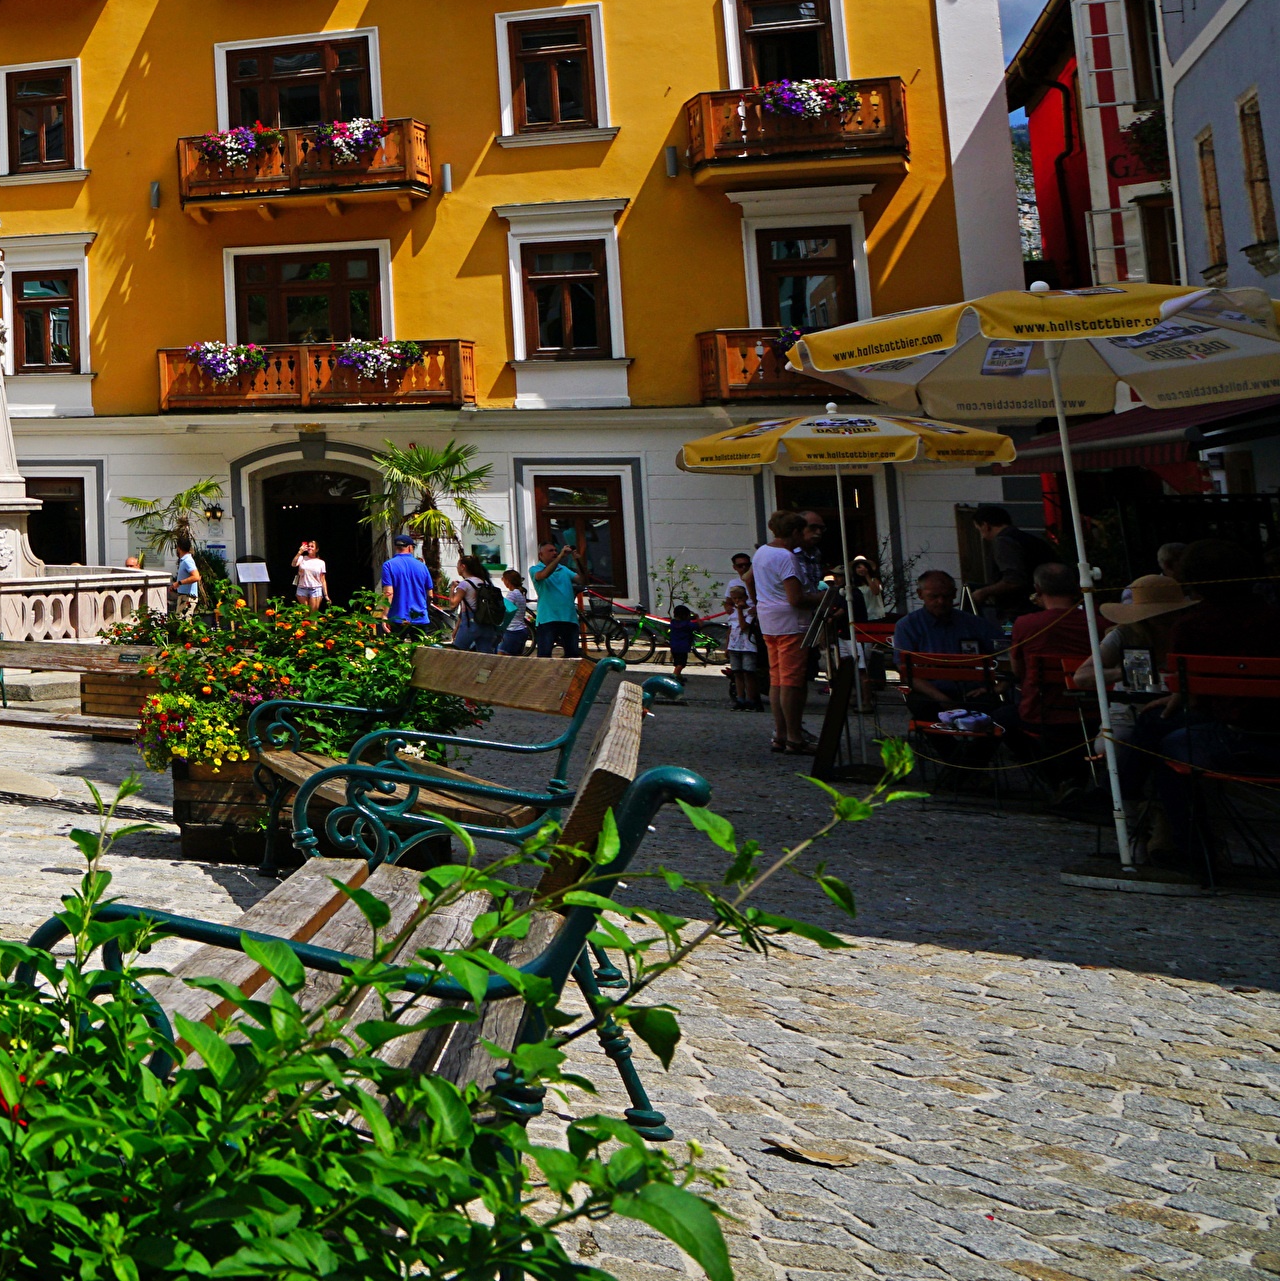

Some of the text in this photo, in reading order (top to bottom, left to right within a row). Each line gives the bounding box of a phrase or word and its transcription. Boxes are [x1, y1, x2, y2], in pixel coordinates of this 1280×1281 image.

[1013, 315, 1161, 335] www.hallstattbier.co
[832, 331, 944, 362] www.hallstattbier.com
[806, 450, 896, 460] www.hallstattbier.com
